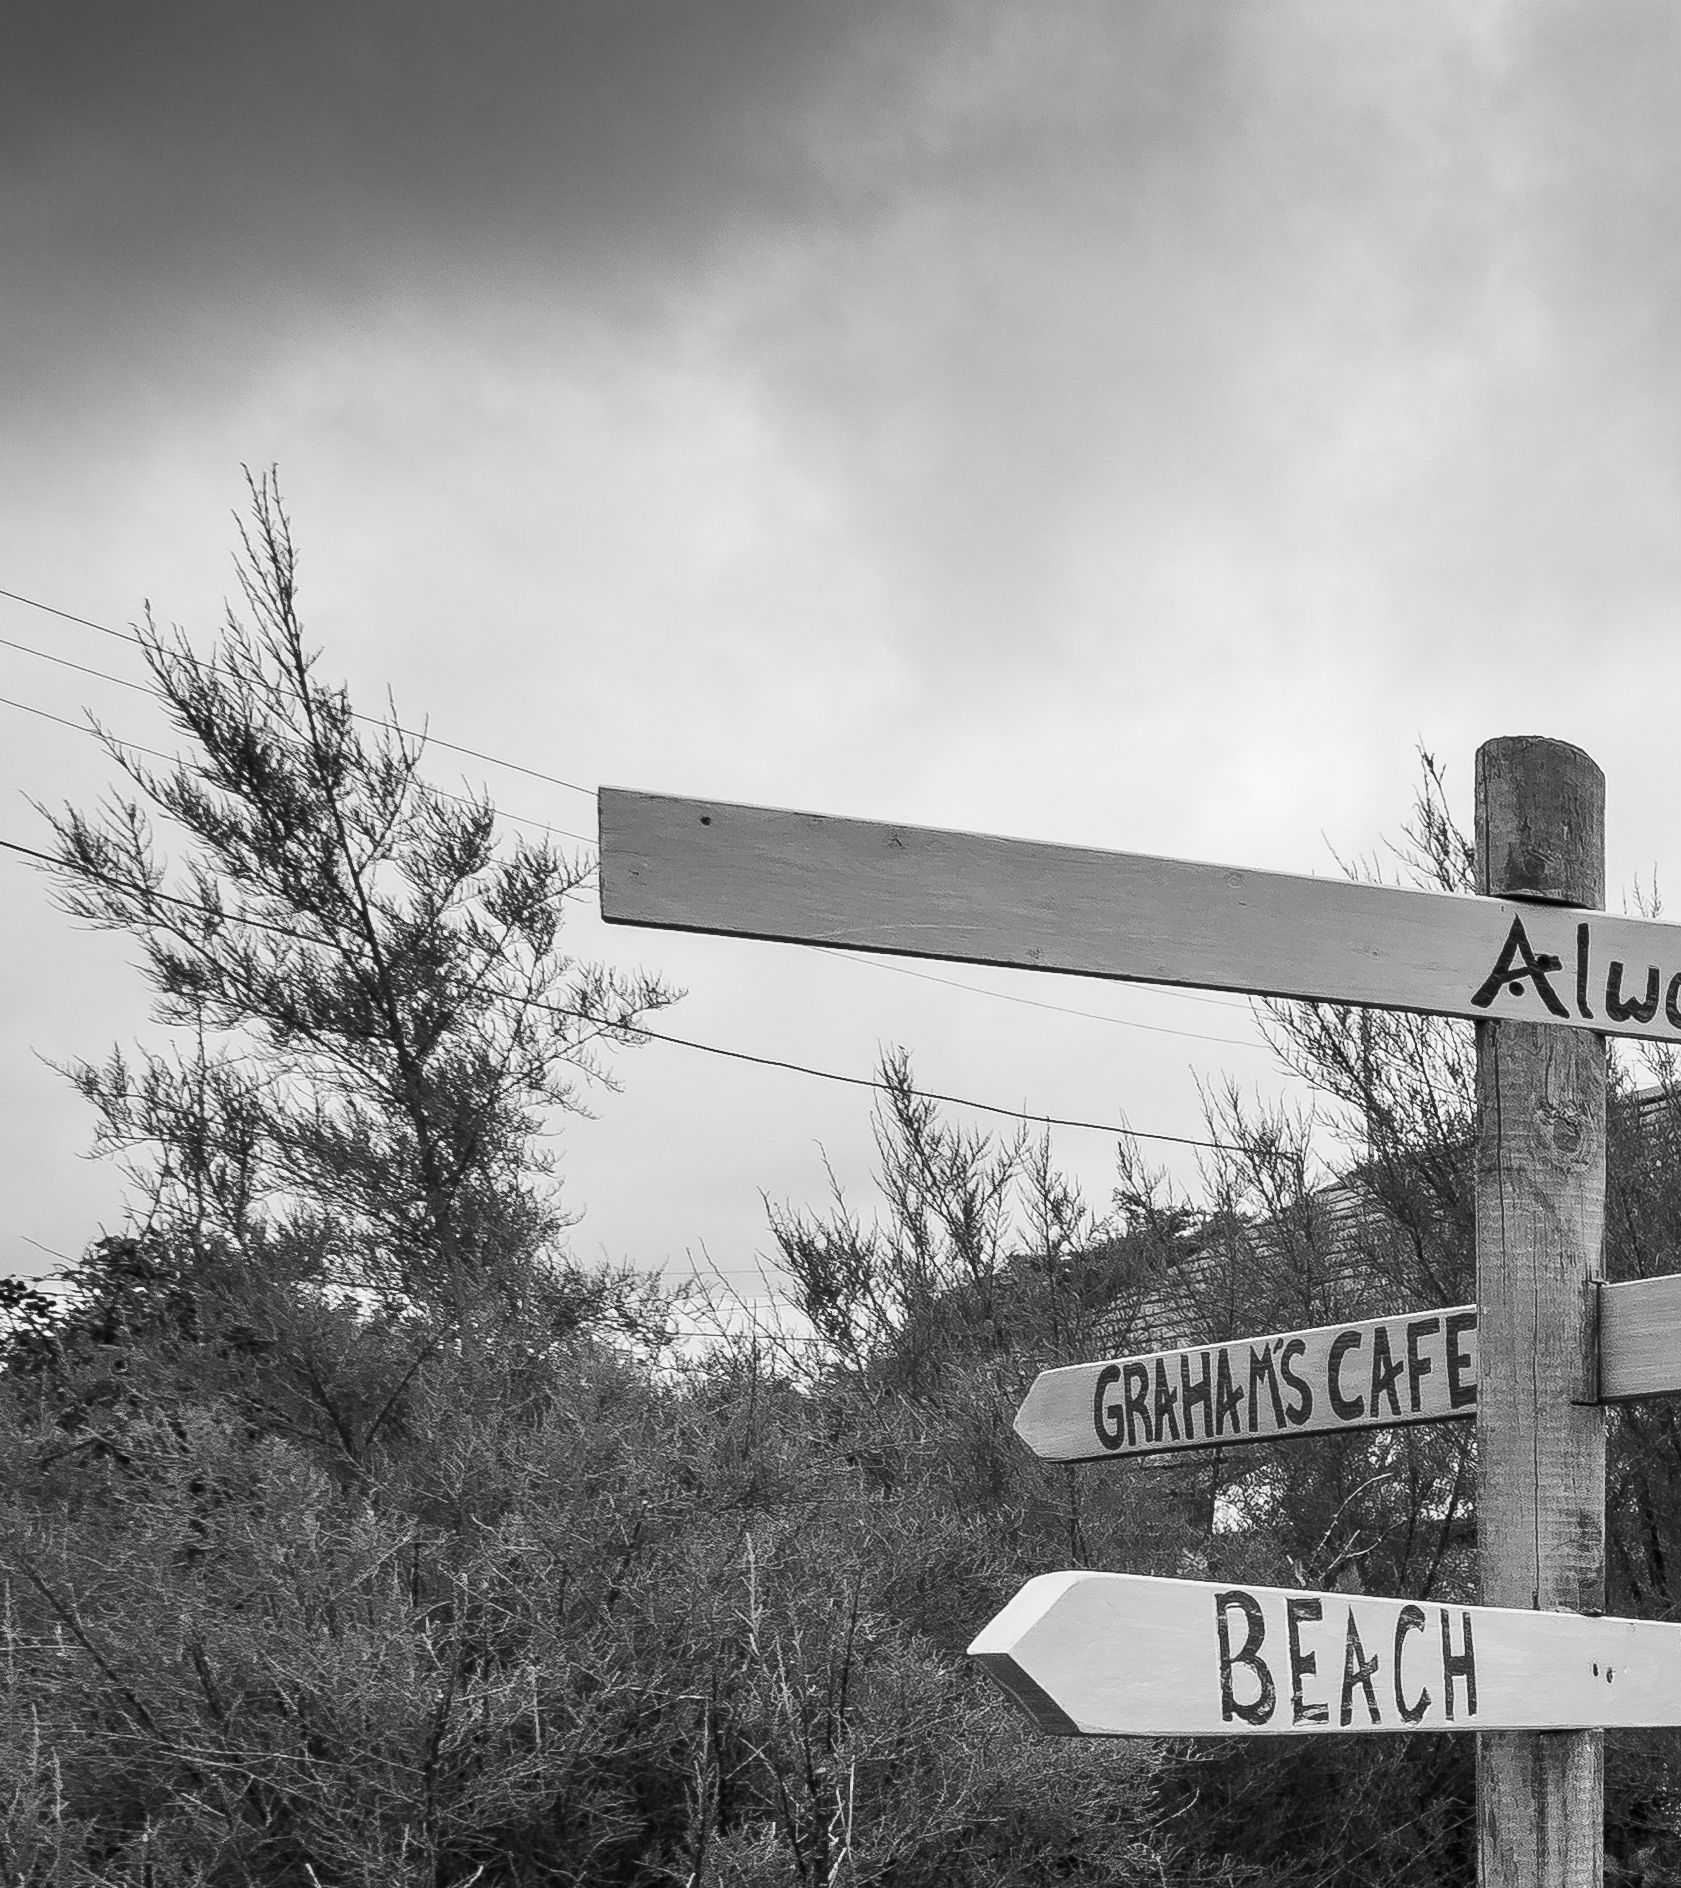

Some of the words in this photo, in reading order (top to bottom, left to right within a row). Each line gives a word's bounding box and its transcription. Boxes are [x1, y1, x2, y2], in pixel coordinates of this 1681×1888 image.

[1094, 1337, 1314, 1452] GRAHAM'S
[1327, 1312, 1478, 1423] CAFE
[1213, 1590, 1480, 1728] BEACH
